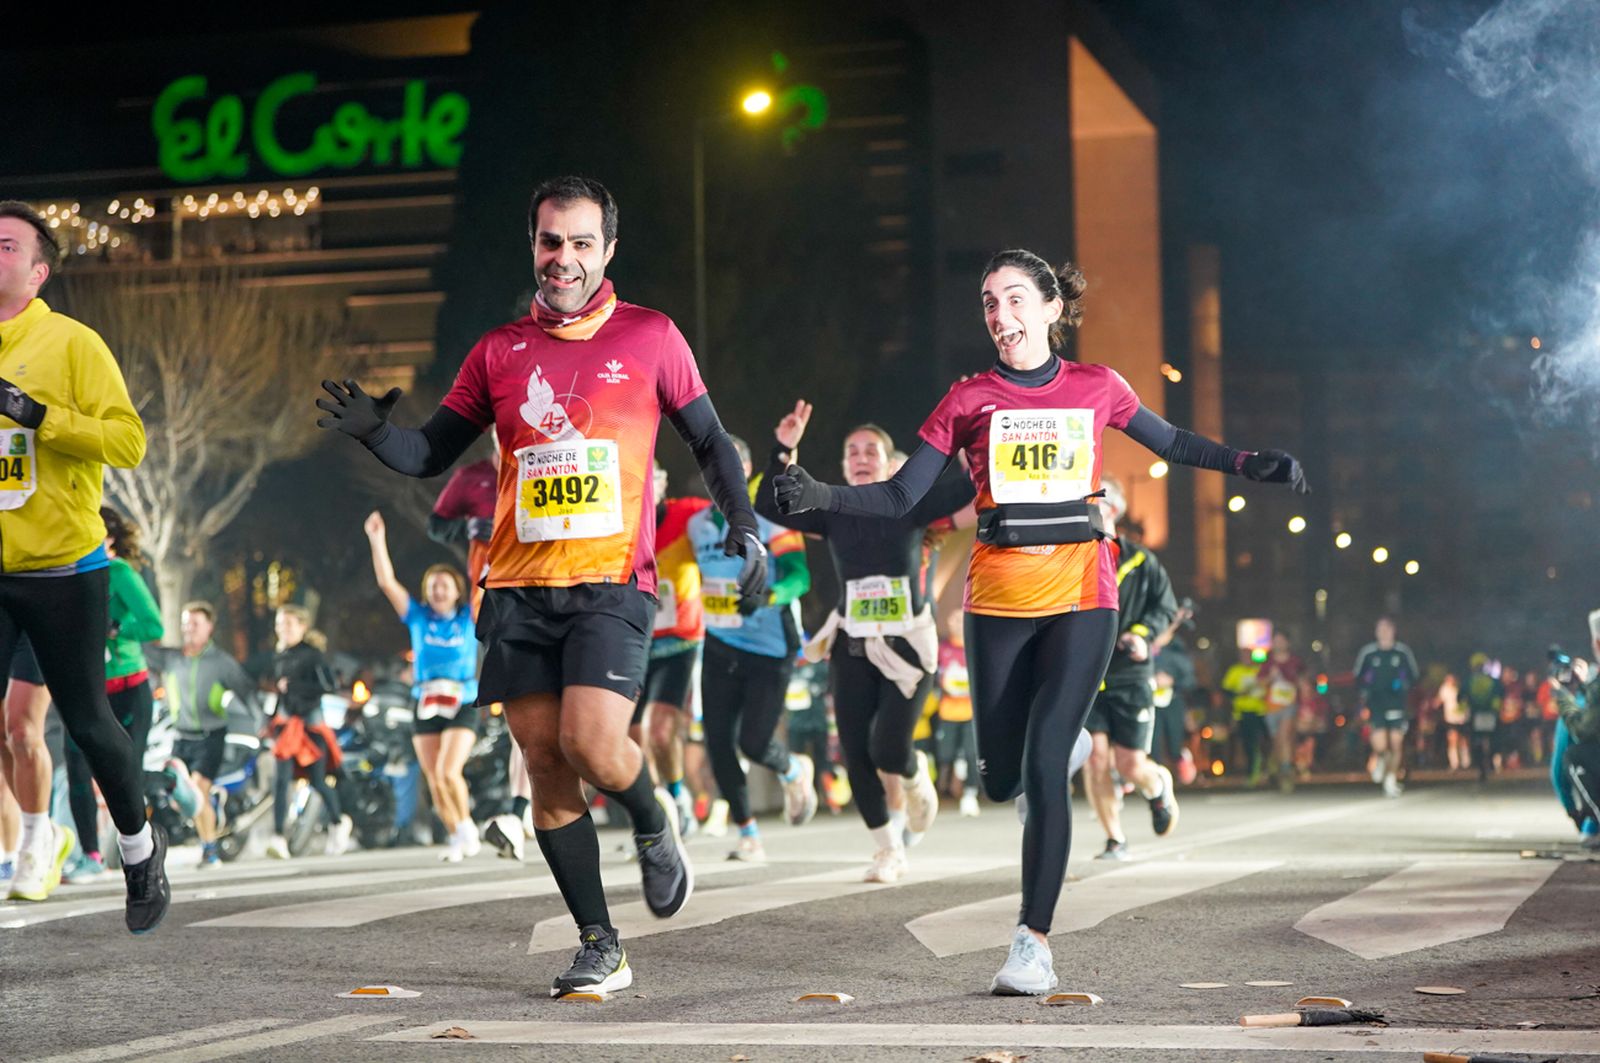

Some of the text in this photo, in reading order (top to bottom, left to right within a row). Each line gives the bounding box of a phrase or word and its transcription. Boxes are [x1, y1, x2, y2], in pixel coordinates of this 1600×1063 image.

[152, 71, 470, 183] El Corte
[1013, 420, 1057, 430] NOCHE DE
[1001, 432, 1021, 443] SAN
[536, 452, 577, 465] NOCHE DE
[527, 467, 543, 479] SAN
[533, 475, 600, 508] 3492
